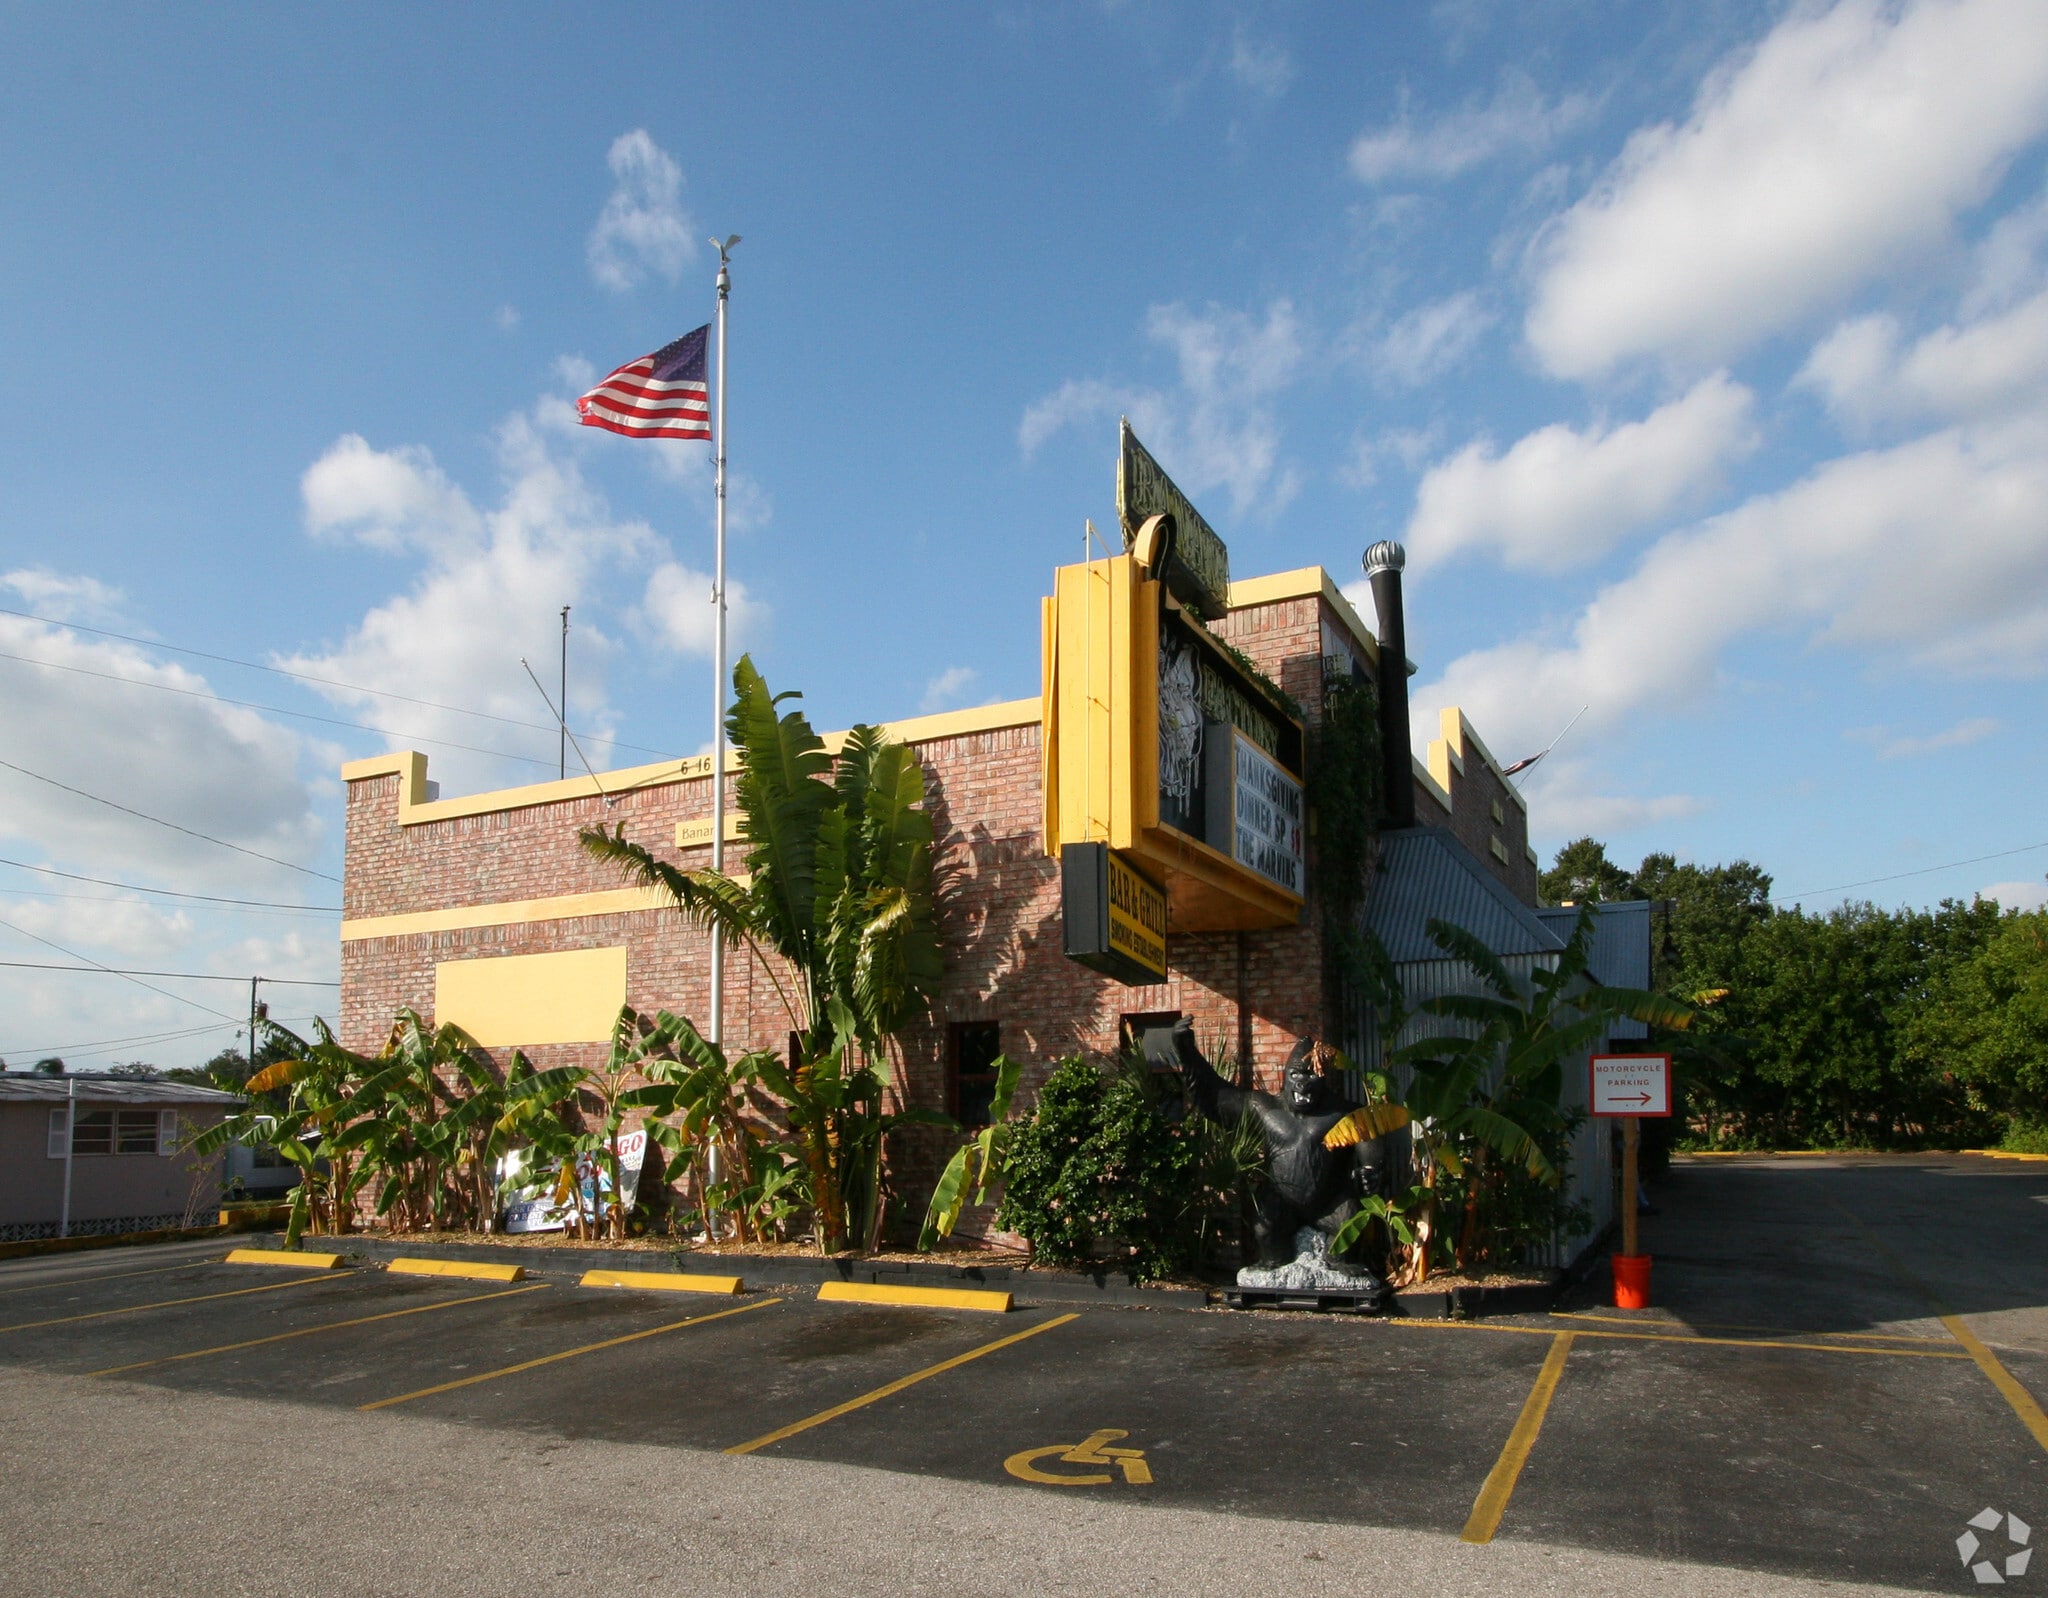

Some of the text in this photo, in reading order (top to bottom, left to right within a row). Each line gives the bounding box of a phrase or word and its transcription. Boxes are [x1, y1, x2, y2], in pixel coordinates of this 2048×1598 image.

[1236, 746, 1299, 820] THANKSGIVING
[682, 827, 713, 840] Banan
[1236, 786, 1272, 839] DINNER
[1275, 813, 1285, 844] SP
[1236, 827, 1254, 866] THE
[1110, 861, 1165, 939] BAR & GRILL
[1111, 917, 1133, 952] SMOKING
[1596, 1065, 1662, 1073] MOTORCYCLE
